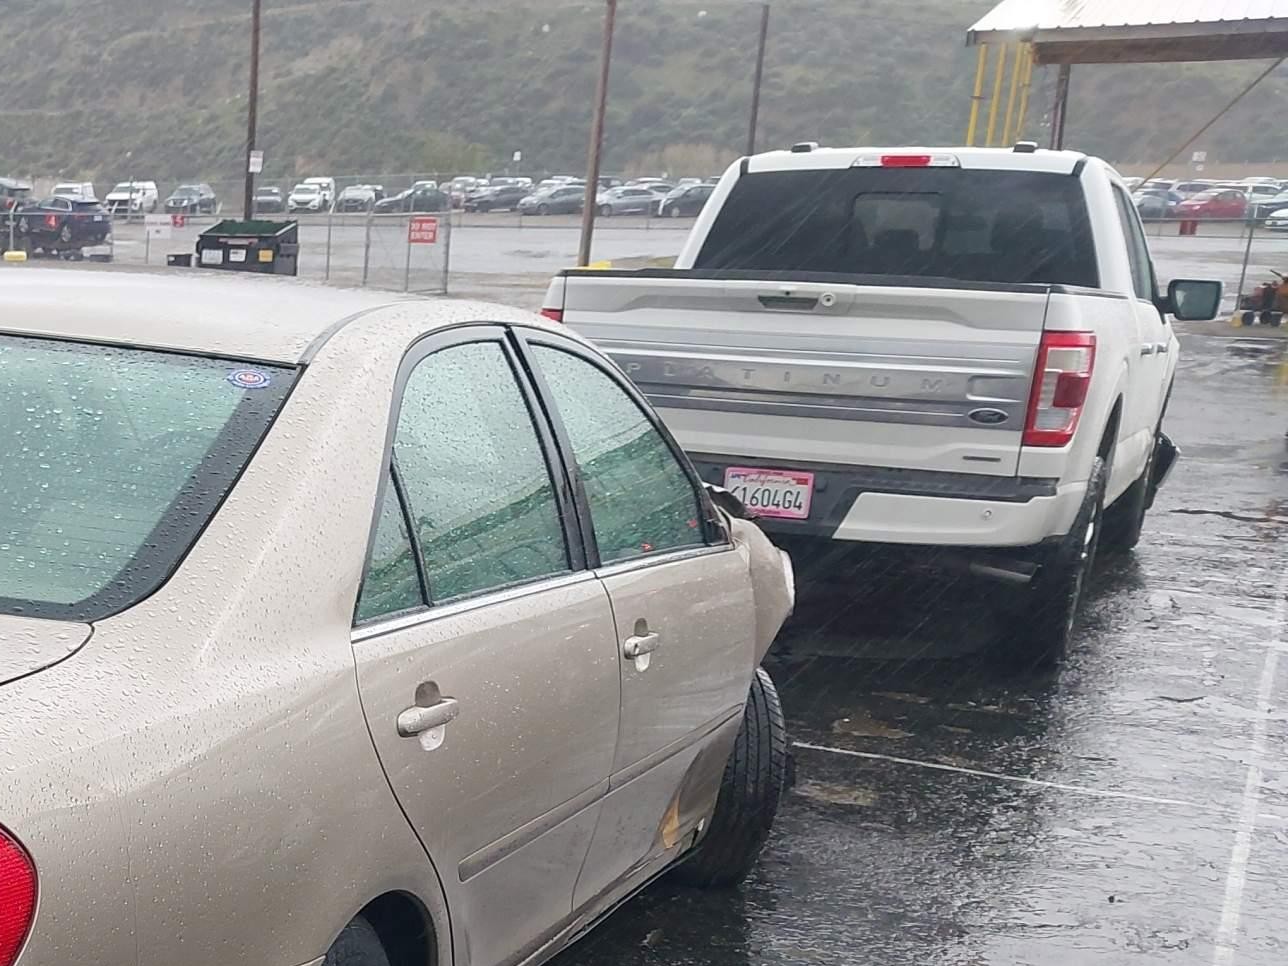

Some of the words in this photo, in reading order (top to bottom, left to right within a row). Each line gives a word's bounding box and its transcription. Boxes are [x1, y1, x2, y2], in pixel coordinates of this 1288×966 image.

[422, 222, 436, 231] NOT
[410, 231, 434, 240] ENTER
[626, 361, 943, 393] PLATINUM
[731, 485, 803, 511] 1604G4
